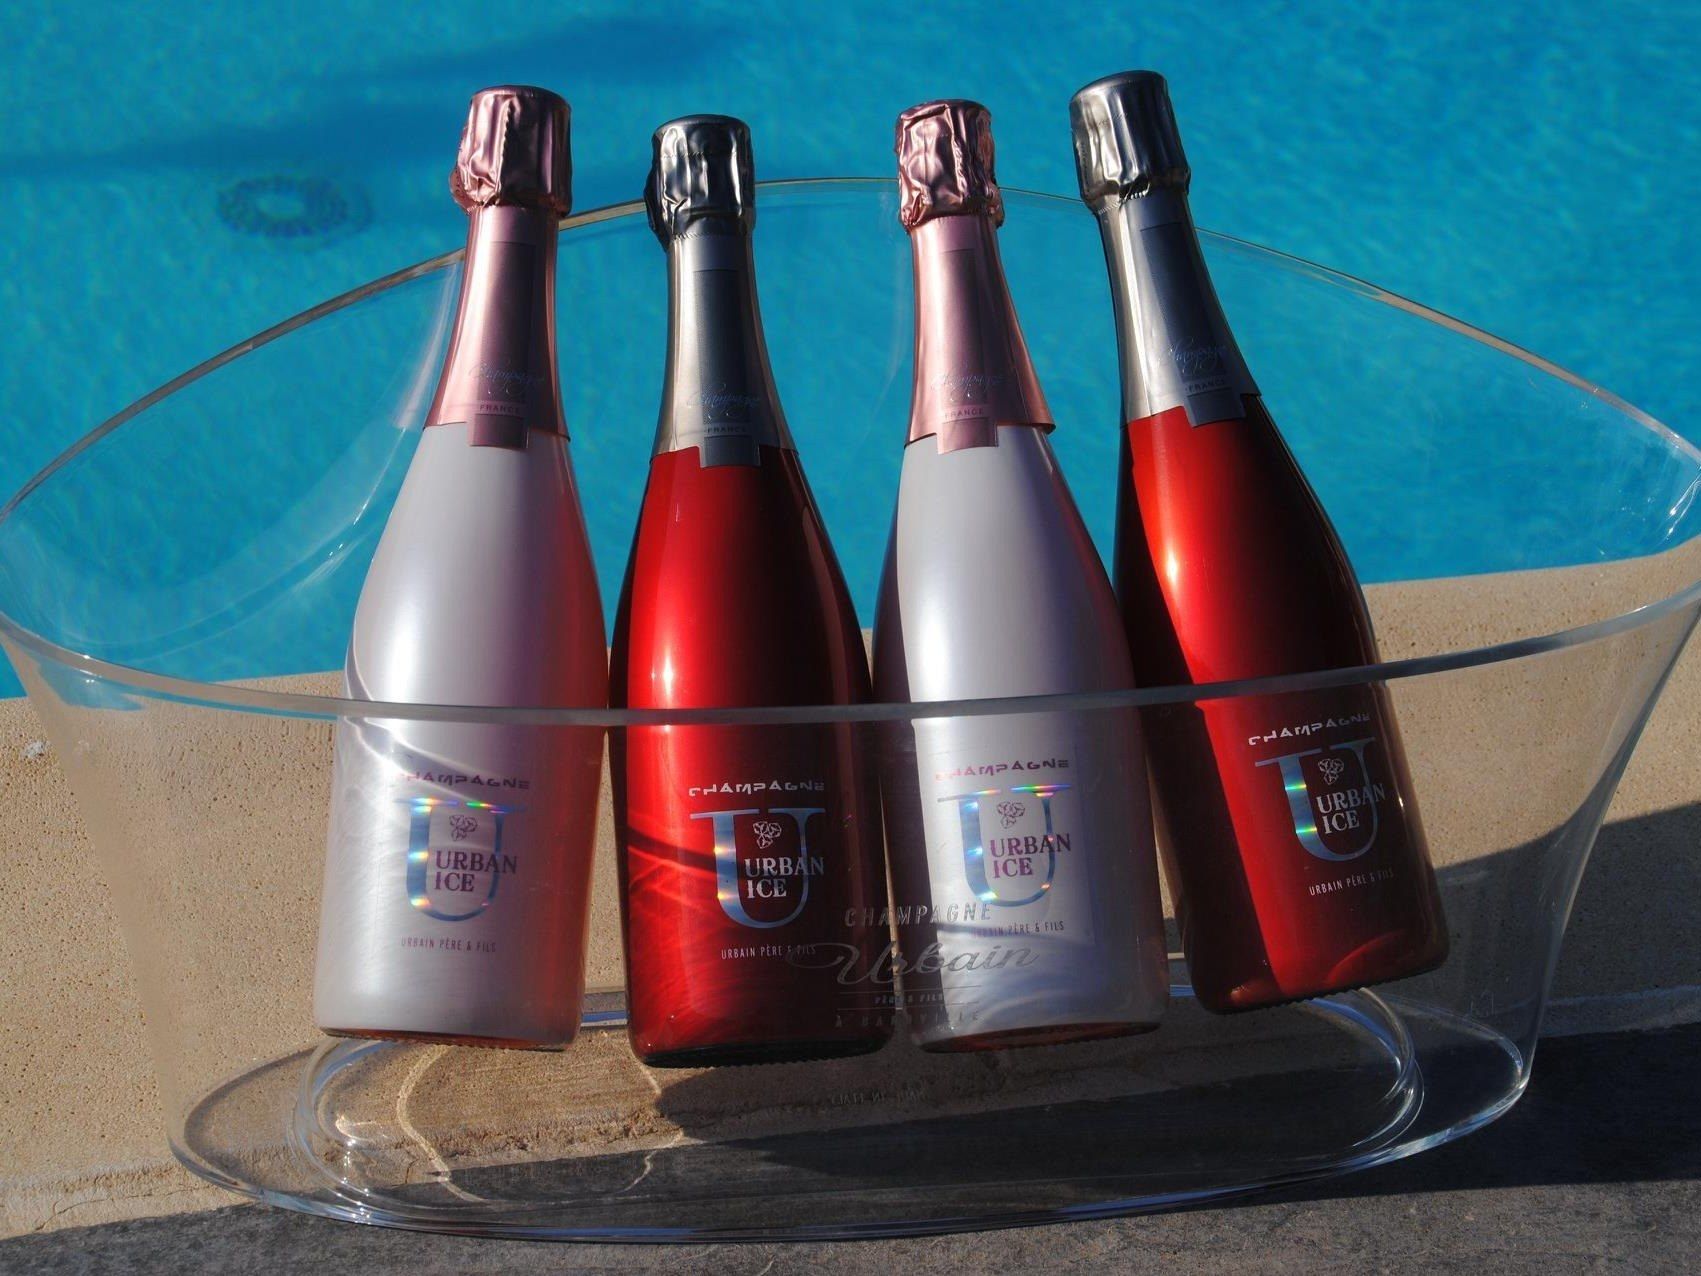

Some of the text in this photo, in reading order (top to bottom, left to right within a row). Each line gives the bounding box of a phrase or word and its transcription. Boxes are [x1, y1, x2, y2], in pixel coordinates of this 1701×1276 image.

[480, 403, 521, 414] FRANCE
[1248, 713, 1371, 746] CHAMPAGNE
[399, 770, 531, 790] HAMPAGNE
[688, 780, 825, 798] CHAMPAGNE
[1316, 783, 1386, 815] URBAN
[1322, 809, 1361, 835] ICE
[988, 833, 1073, 859] URBAN
[435, 850, 518, 875] URBAN
[743, 856, 825, 878] URBAN
[991, 857, 1034, 880] ICE
[433, 871, 476, 893] ICE
[746, 878, 788, 899] ICE
[1309, 880, 1343, 896] URBAIN
[844, 902, 992, 928] CHAMPAGNE
[1045, 920, 1065, 932] FILS
[439, 935, 461, 949] PÈRE
[721, 948, 756, 960] URBAIN
[760, 944, 783, 957] PÈRE
[785, 941, 1040, 985] Urbain
